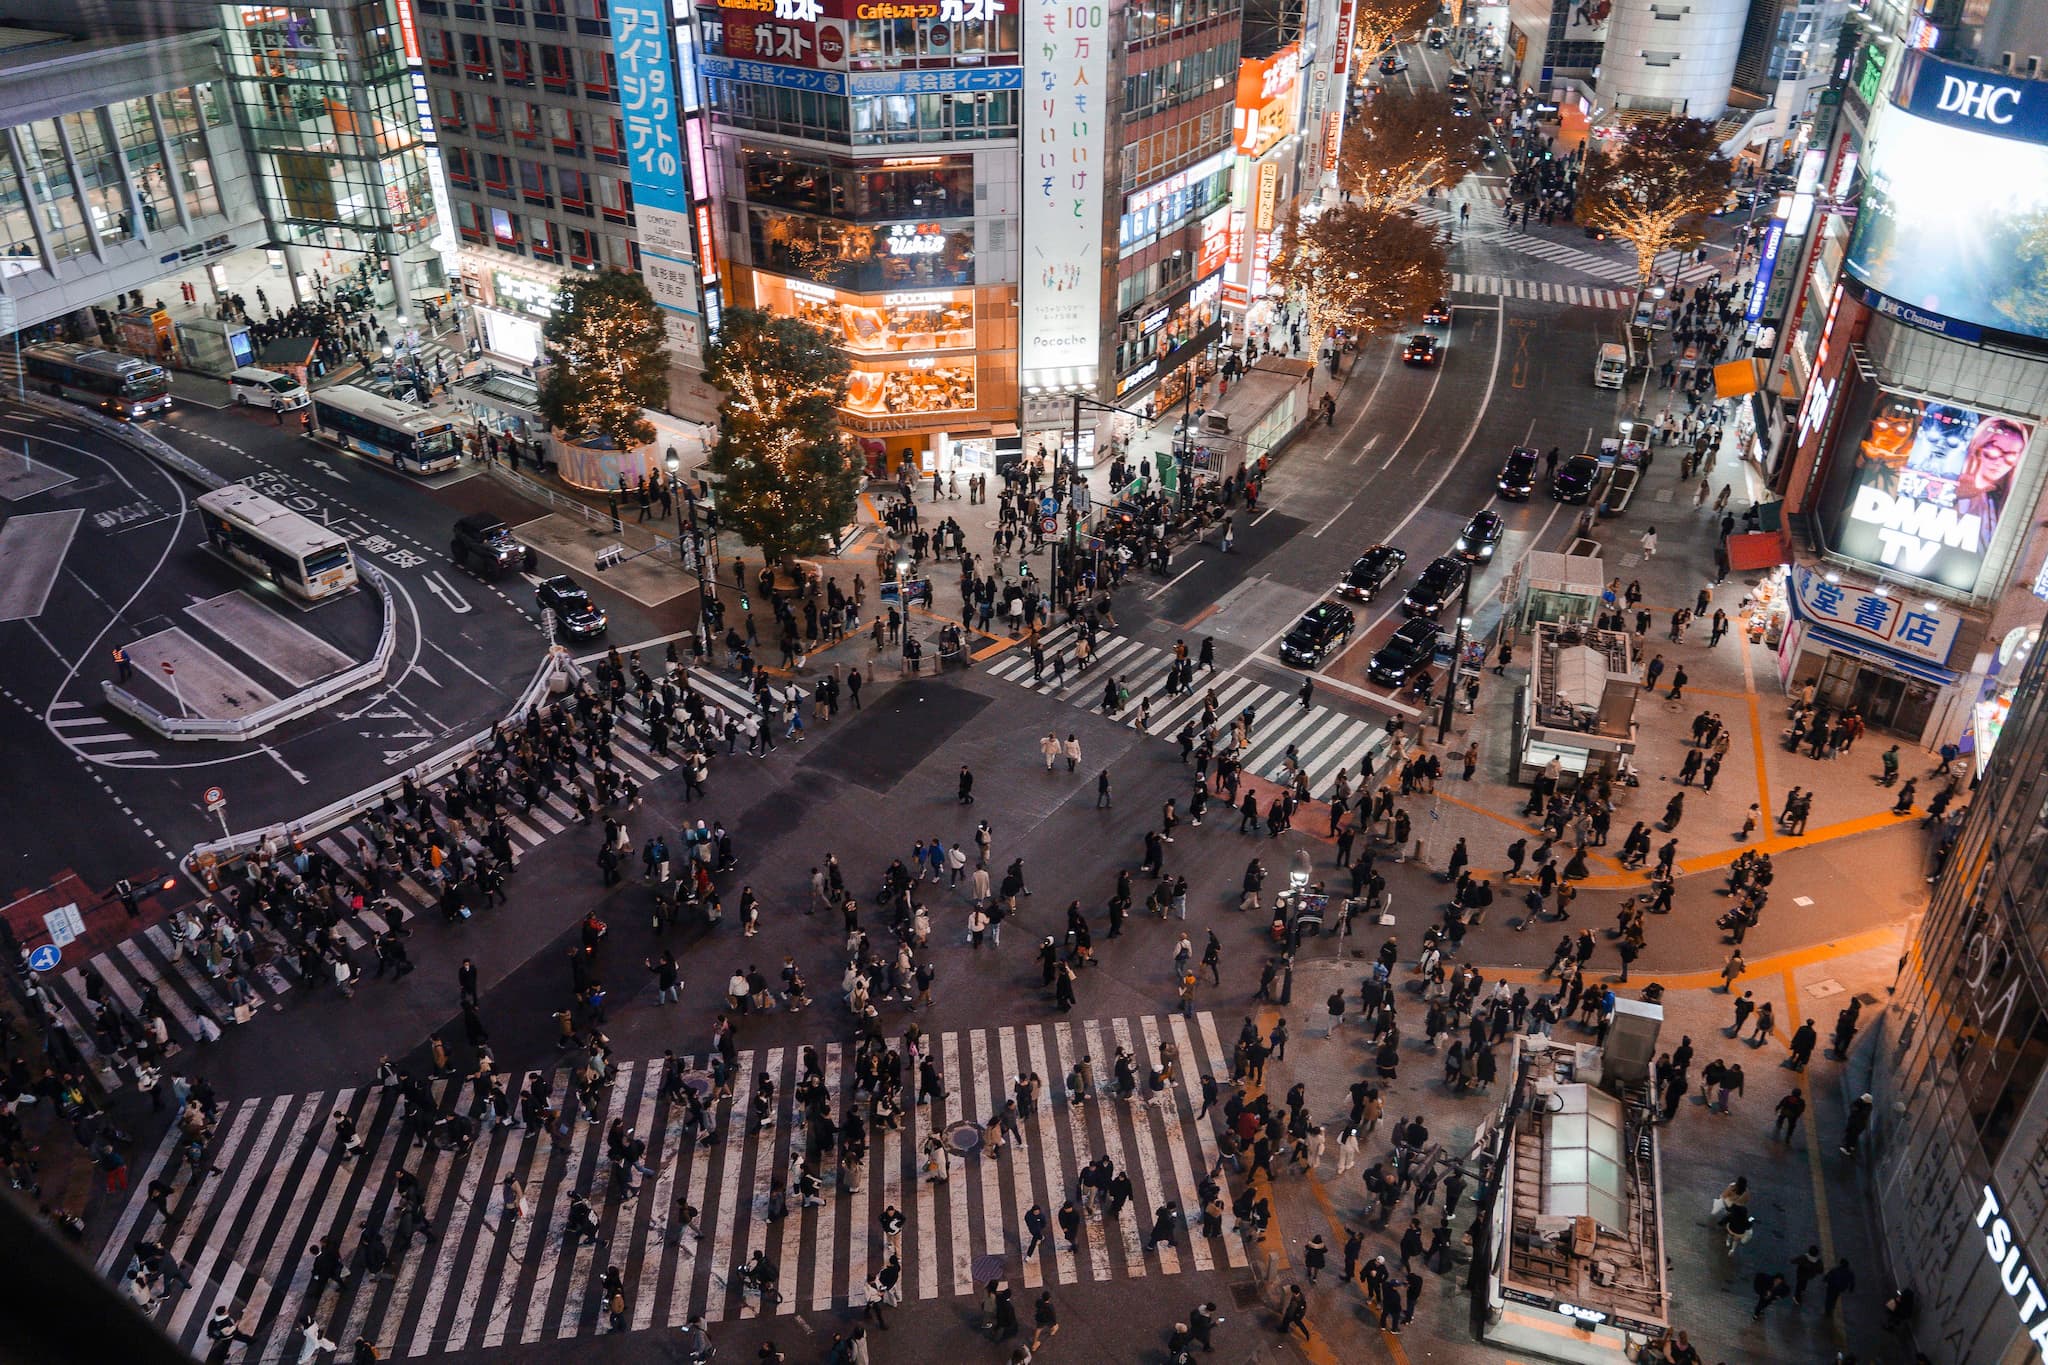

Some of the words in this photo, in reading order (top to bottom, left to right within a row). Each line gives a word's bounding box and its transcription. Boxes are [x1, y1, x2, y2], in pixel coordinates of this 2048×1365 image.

[702, 21, 723, 41] 7F
[755, 23, 811, 60] ガスト
[614, 6, 653, 173] アイシティ
[641, 9, 676, 177] コンタクトの
[904, 71, 1020, 93] 英会話イーオン
[1937, 75, 2021, 124] DHC
[1878, 527, 1941, 573] TV
